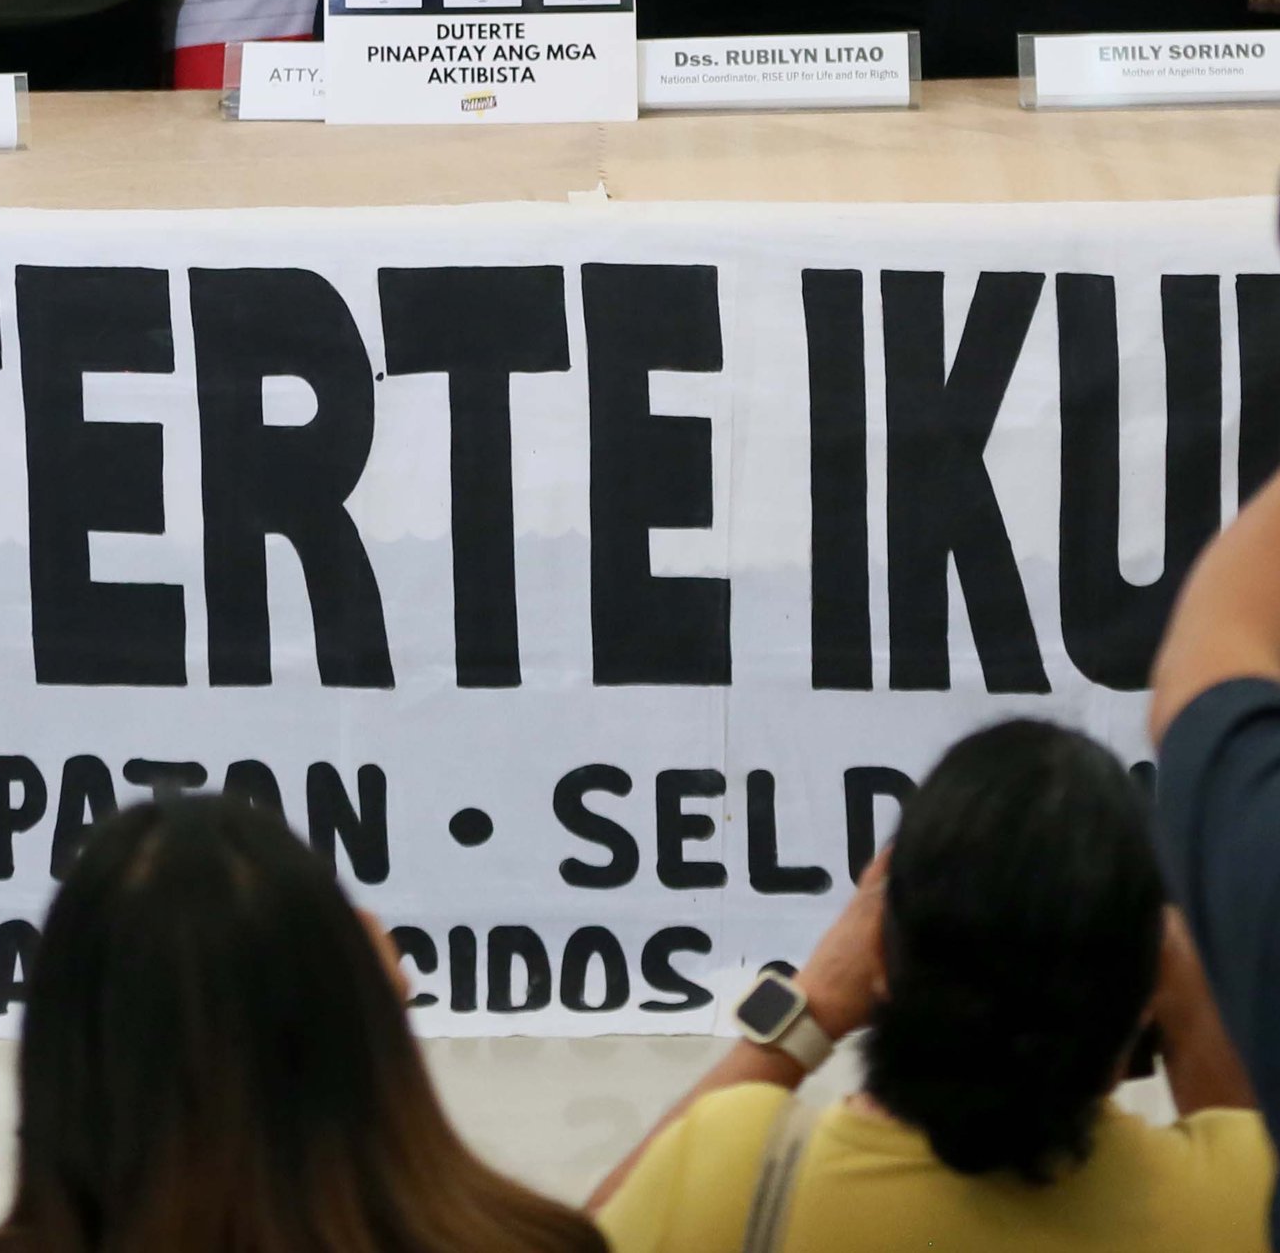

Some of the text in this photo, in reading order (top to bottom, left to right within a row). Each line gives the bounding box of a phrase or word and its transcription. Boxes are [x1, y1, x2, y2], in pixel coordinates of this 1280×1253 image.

[437, 23, 524, 40] DUTERTE
[367, 44, 596, 62] PINAPATAY ANG MGA
[674, 46, 884, 67] Dss. RUBILYN LITAO
[1099, 44, 1265, 62] EMILY SORIANO
[269, 68, 324, 83] ATTY.
[427, 67, 536, 84] AKTIBISTA
[660, 69, 899, 84] National Coordinator, RISE UP for Life and for Rights
[1122, 66, 1244, 78] Mother of Angelito Soriano
[552, 762, 918, 894] SELD
